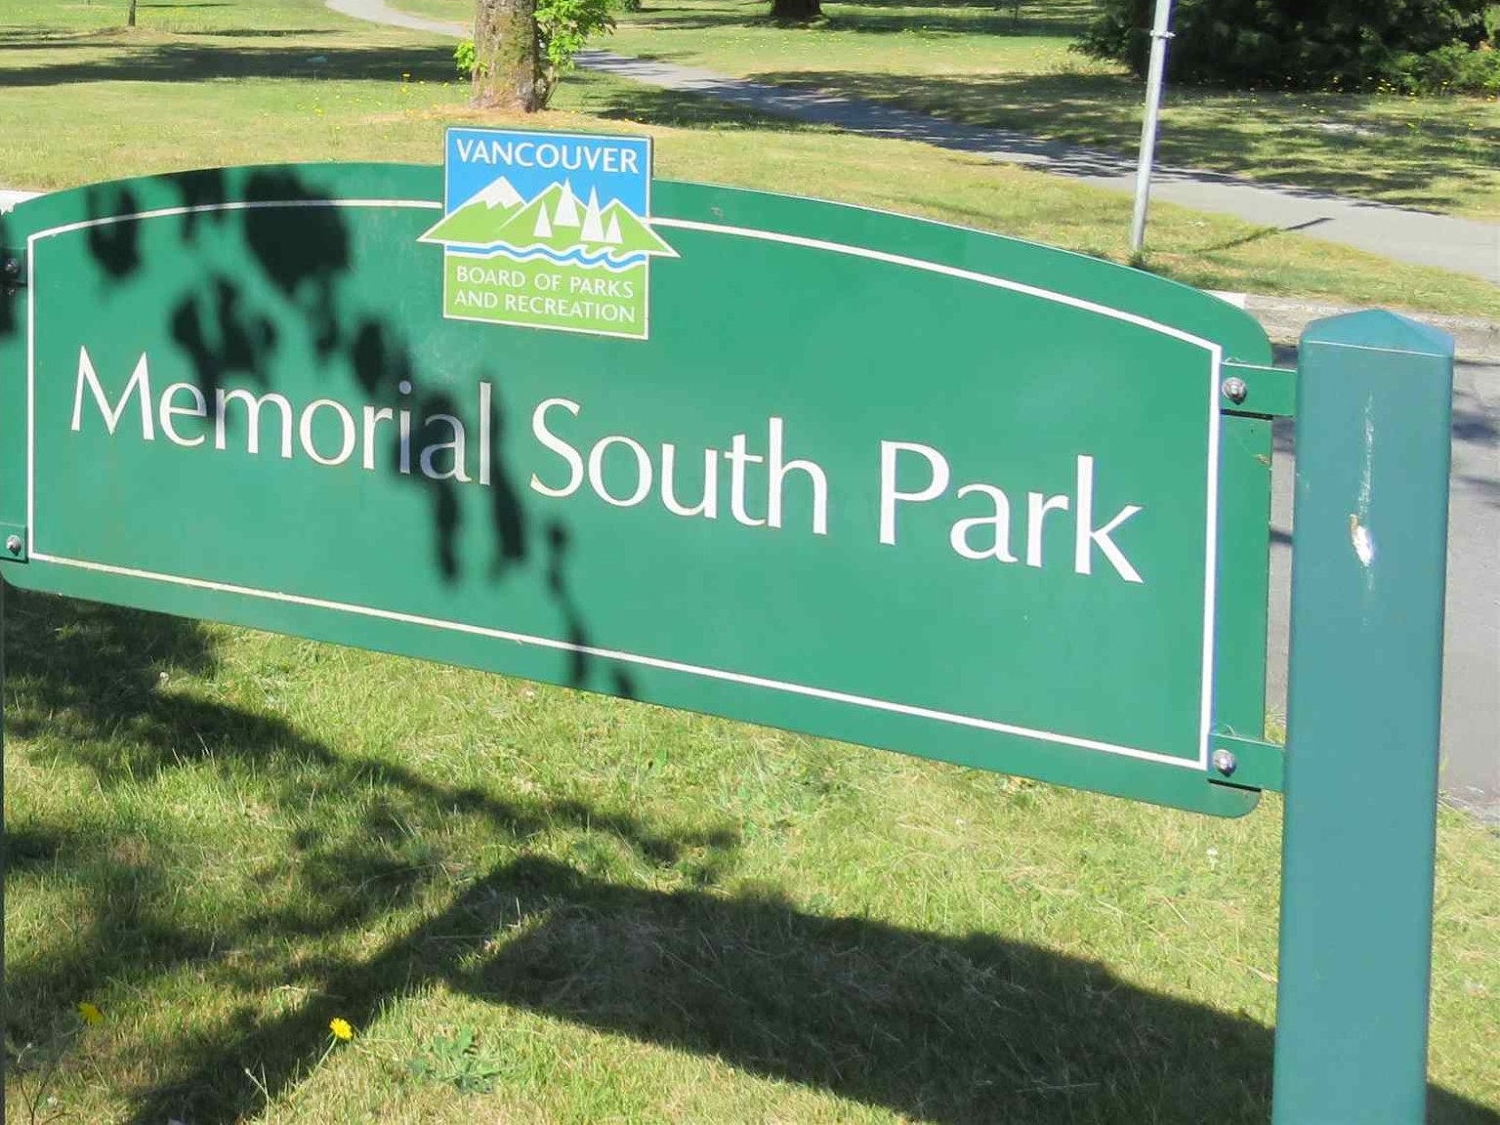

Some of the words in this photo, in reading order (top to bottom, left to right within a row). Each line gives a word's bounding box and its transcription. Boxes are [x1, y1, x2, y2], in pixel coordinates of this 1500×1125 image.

[456, 138, 639, 174] VANCOUVER
[456, 265, 527, 288] BOARD
[534, 273, 563, 291] OF
[569, 276, 634, 299] PARKS
[454, 290, 498, 309] AND
[505, 293, 635, 323] RECREATION
[70, 345, 492, 486] Memorial
[529, 397, 829, 536] South
[879, 440, 1145, 585] Park
